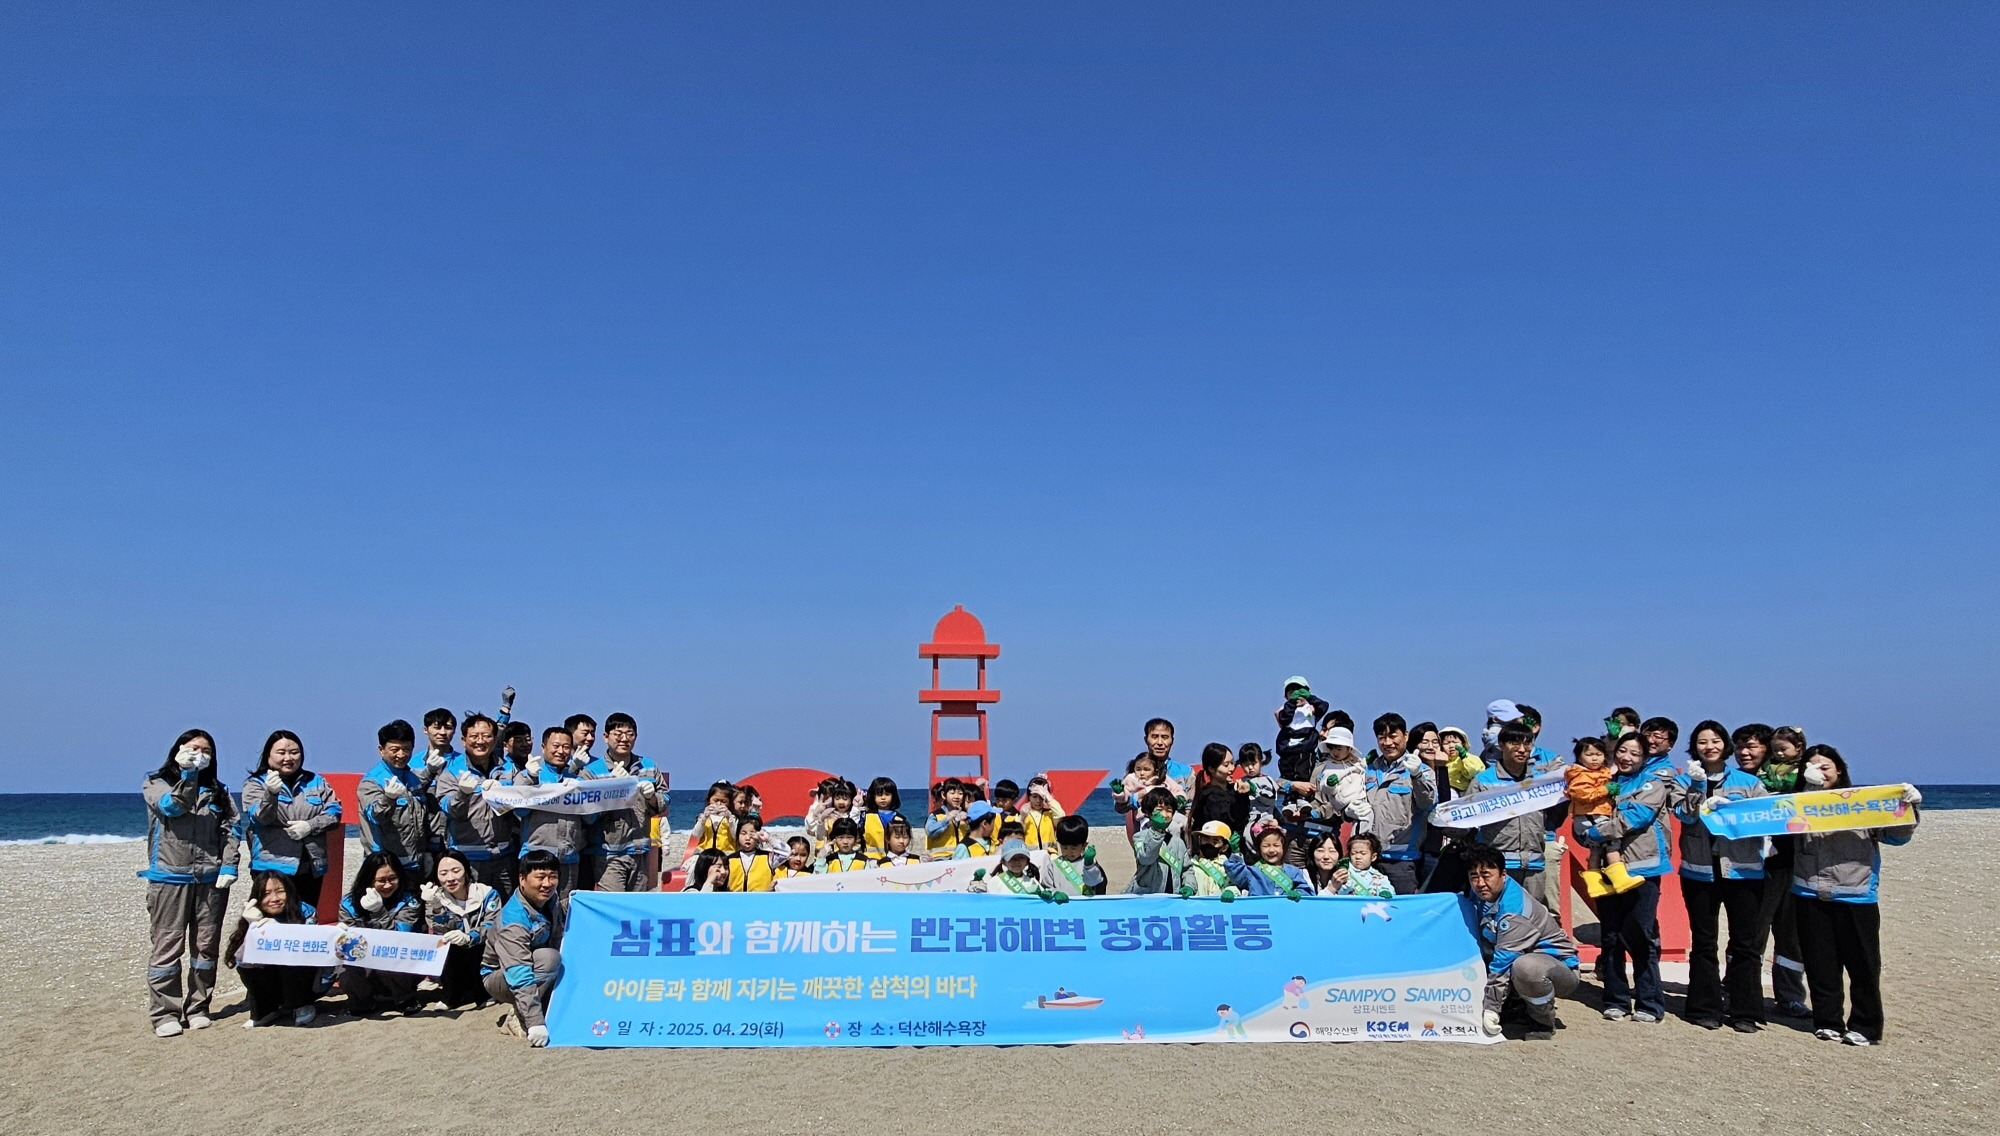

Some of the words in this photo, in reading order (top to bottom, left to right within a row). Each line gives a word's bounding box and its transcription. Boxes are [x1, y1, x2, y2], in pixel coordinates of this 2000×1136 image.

[563, 791, 601, 806] SUPER
[1450, 806, 1477, 822] 맑고!
[1479, 792, 1526, 814] 깨끗하고!
[610, 918, 735, 957] 삼표와
[745, 920, 897, 954] 함께하는
[910, 916, 1087, 953] 반려해변
[1100, 914, 1273, 952] 정화활동
[256, 938, 282, 951] 오늘의
[284, 939, 300, 952] 작은
[302, 940, 330, 954] 변화로,
[371, 945, 397, 959] 내일의
[400, 946, 408, 959] 큰
[410, 947, 438, 962] 변화를!
[603, 978, 686, 1002] 아이들과
[691, 977, 731, 1002] 함께
[736, 977, 797, 1002] 지키는
[802, 976, 863, 1000] 깨끗한
[868, 975, 930, 1000] 삼척의
[935, 975, 978, 999] 바다
[1324, 987, 1397, 1003] SAMPYO
[1404, 987, 1472, 1003] SAMPYO
[1352, 1004, 1396, 1014] 삼표시멘트
[1440, 1004, 1474, 1014] 삼표산업
[617, 1021, 631, 1036] 일
[667, 1022, 708, 1036] 2025.
[712, 1022, 735, 1036] 04.
[740, 1020, 784, 1038] 29(화)
[847, 1021, 862, 1037] 장
[898, 1020, 987, 1038] 덕산해수욕장
[1315, 1026, 1359, 1036] 해양수산부
[1366, 1021, 1409, 1032] KOEM
[1441, 1026, 1478, 1035] 삼척시
